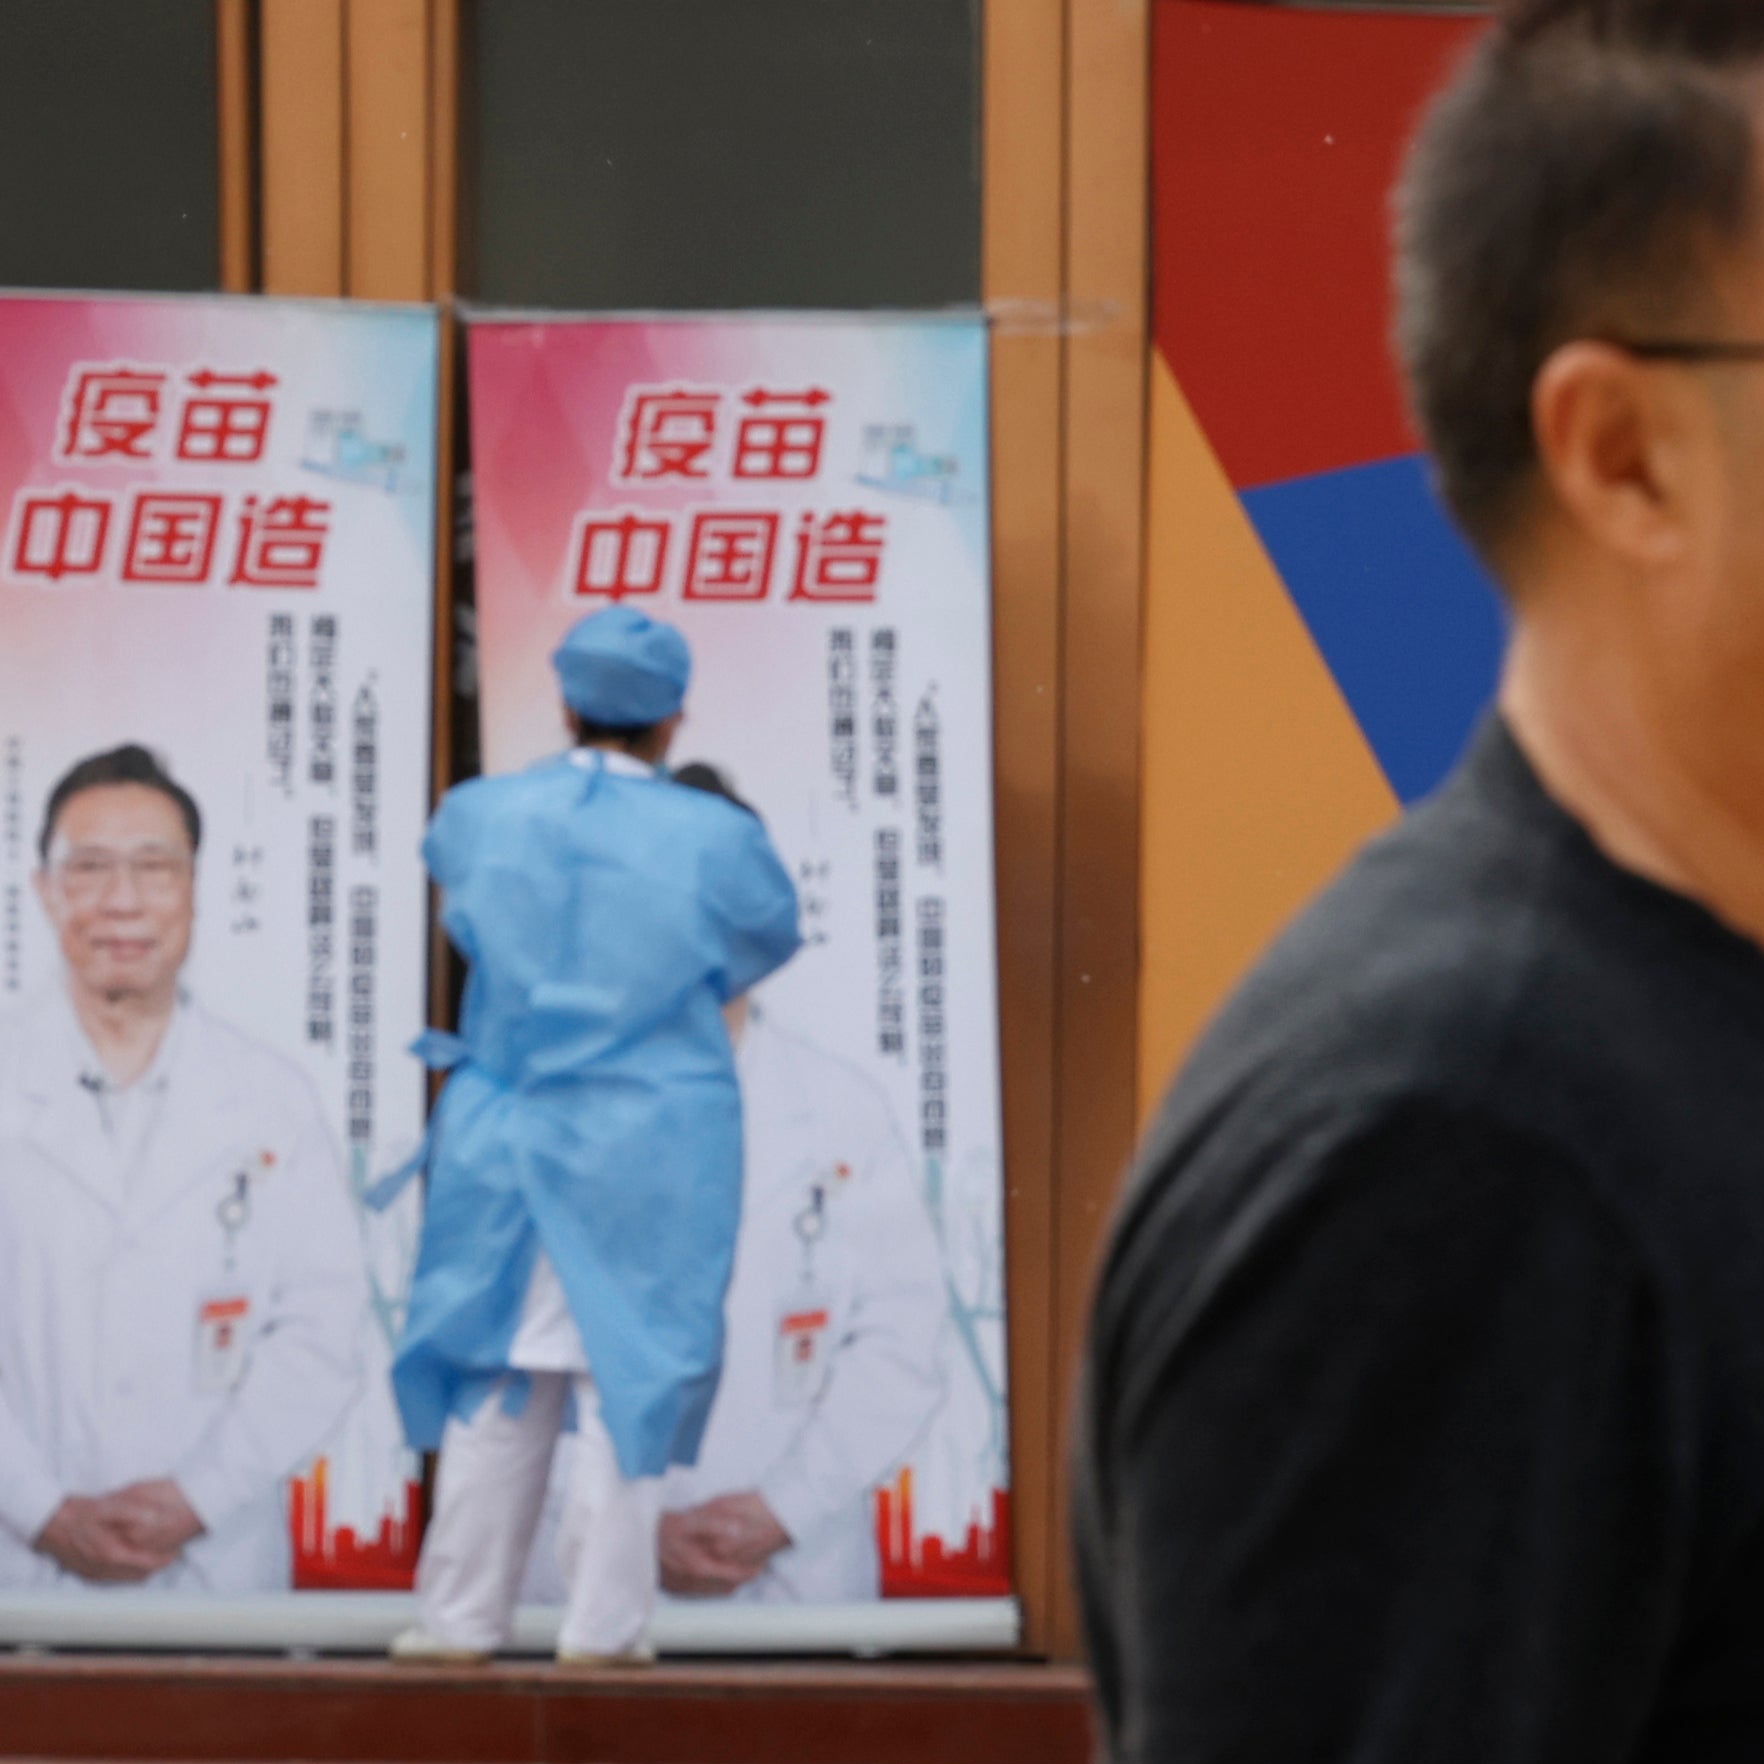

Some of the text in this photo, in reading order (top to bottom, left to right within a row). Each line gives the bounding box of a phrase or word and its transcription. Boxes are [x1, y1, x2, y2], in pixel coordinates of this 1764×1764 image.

[64, 366, 278, 462] 疫苗
[619, 388, 833, 480] 疫苗
[12, 491, 331, 590] 中国造
[573, 511, 887, 604] 中国造
